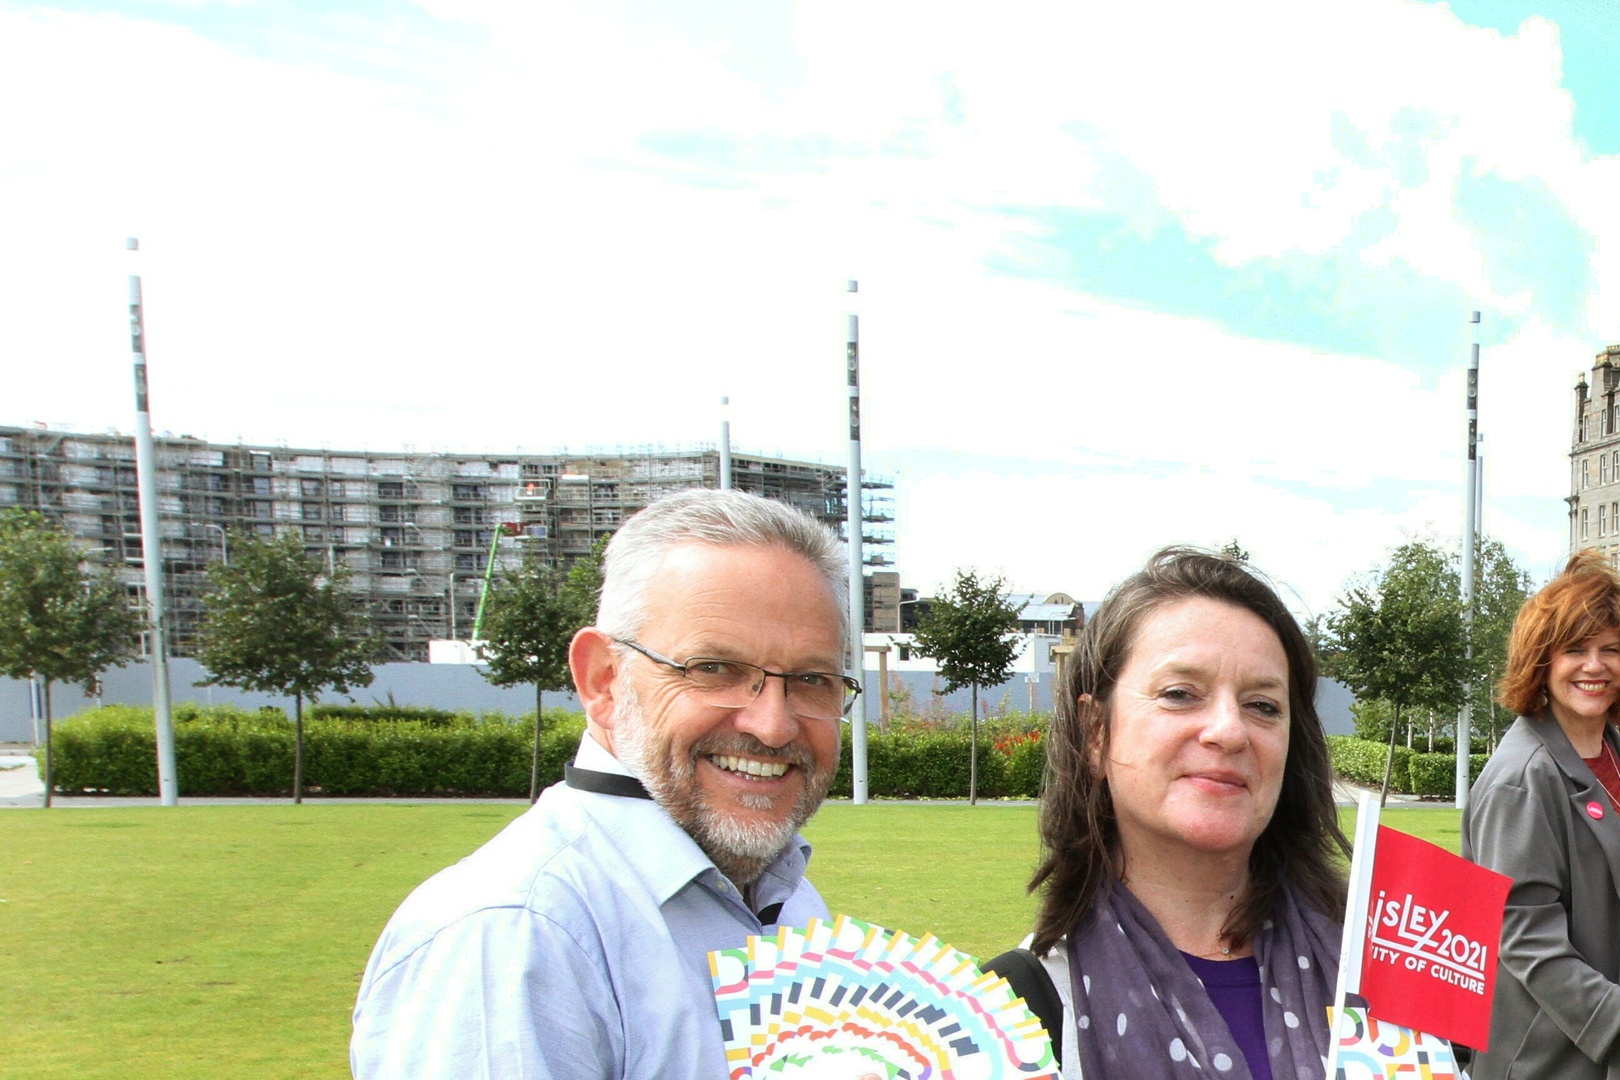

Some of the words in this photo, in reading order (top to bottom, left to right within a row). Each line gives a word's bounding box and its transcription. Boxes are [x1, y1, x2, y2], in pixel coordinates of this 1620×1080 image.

[1371, 945, 1400, 965] ITY
[1404, 956, 1427, 973] OF
[1430, 964, 1486, 996] CULTURE
[1436, 928, 1488, 972] 2021
